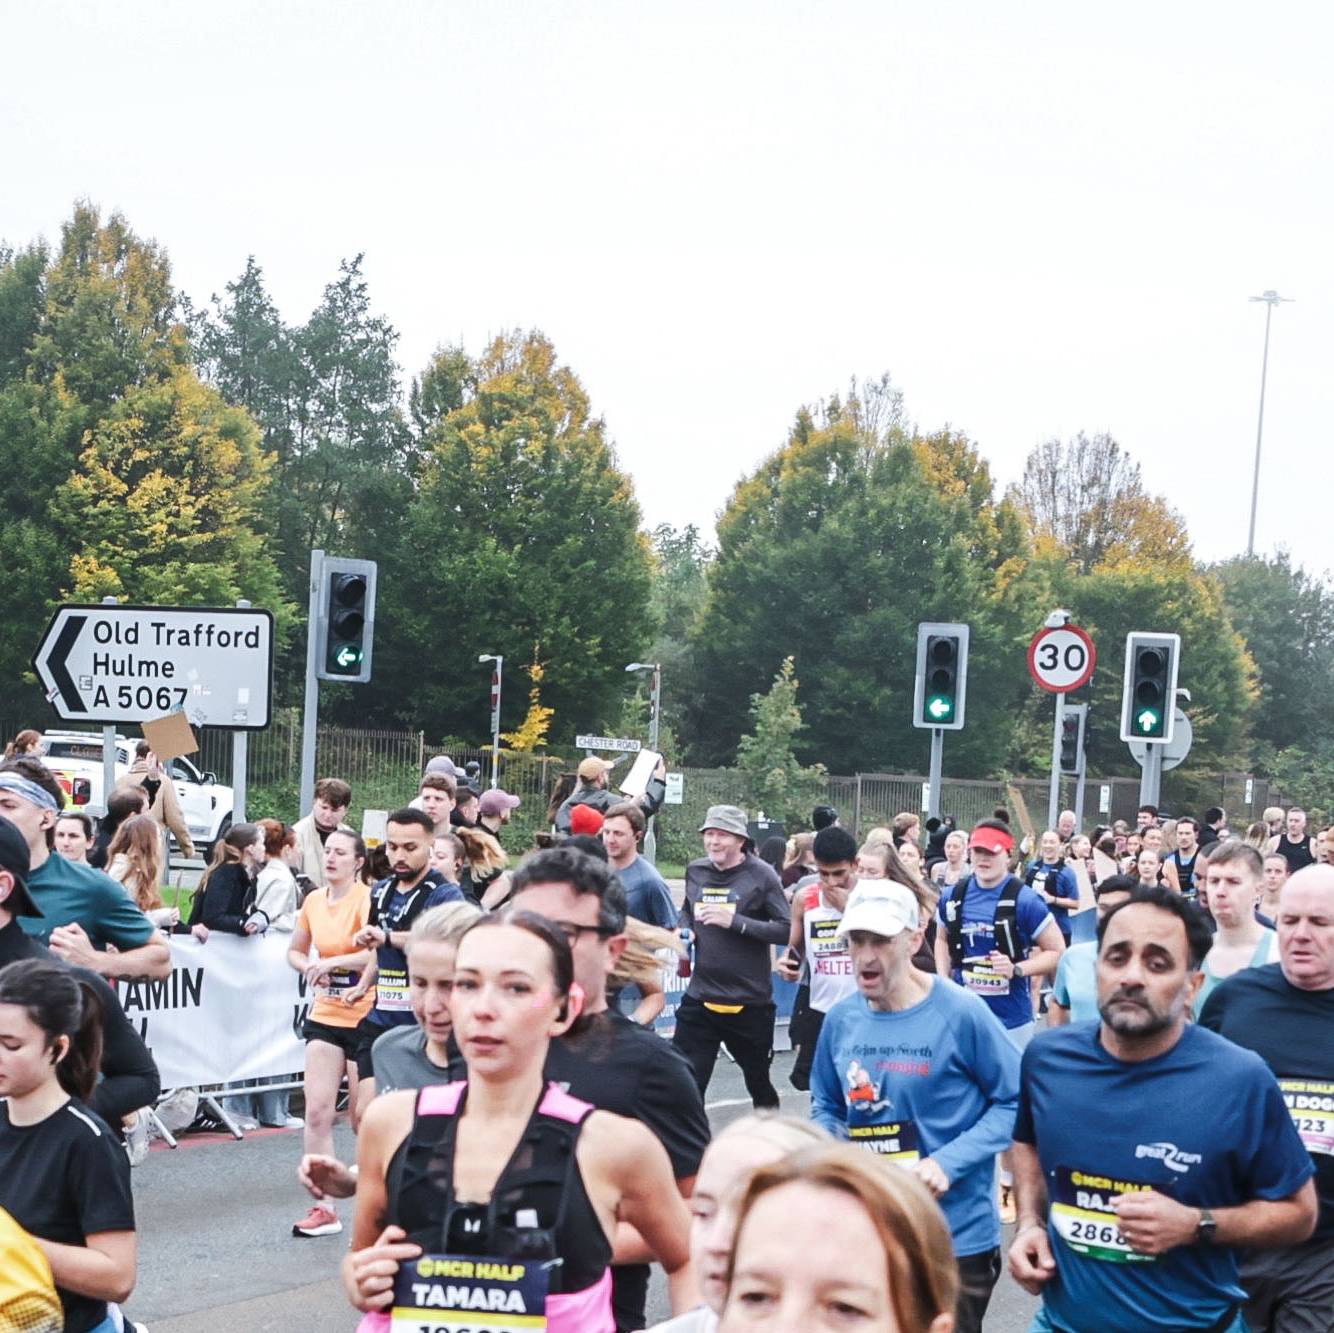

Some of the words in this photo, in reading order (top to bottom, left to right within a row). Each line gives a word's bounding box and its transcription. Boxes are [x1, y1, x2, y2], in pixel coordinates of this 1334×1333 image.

[93, 620, 139, 645] Old
[151, 622, 260, 648] Trafford
[93, 652, 175, 678] Hulme
[1039, 643, 1086, 671] 30
[578, 738, 614, 749] CHESTER
[616, 740, 639, 751] ROAD
[123, 967, 204, 1012] AMIN
[435, 1260, 473, 1279] MCR
[476, 1262, 526, 1282] HALF
[411, 1283, 527, 1313] TAMARA
